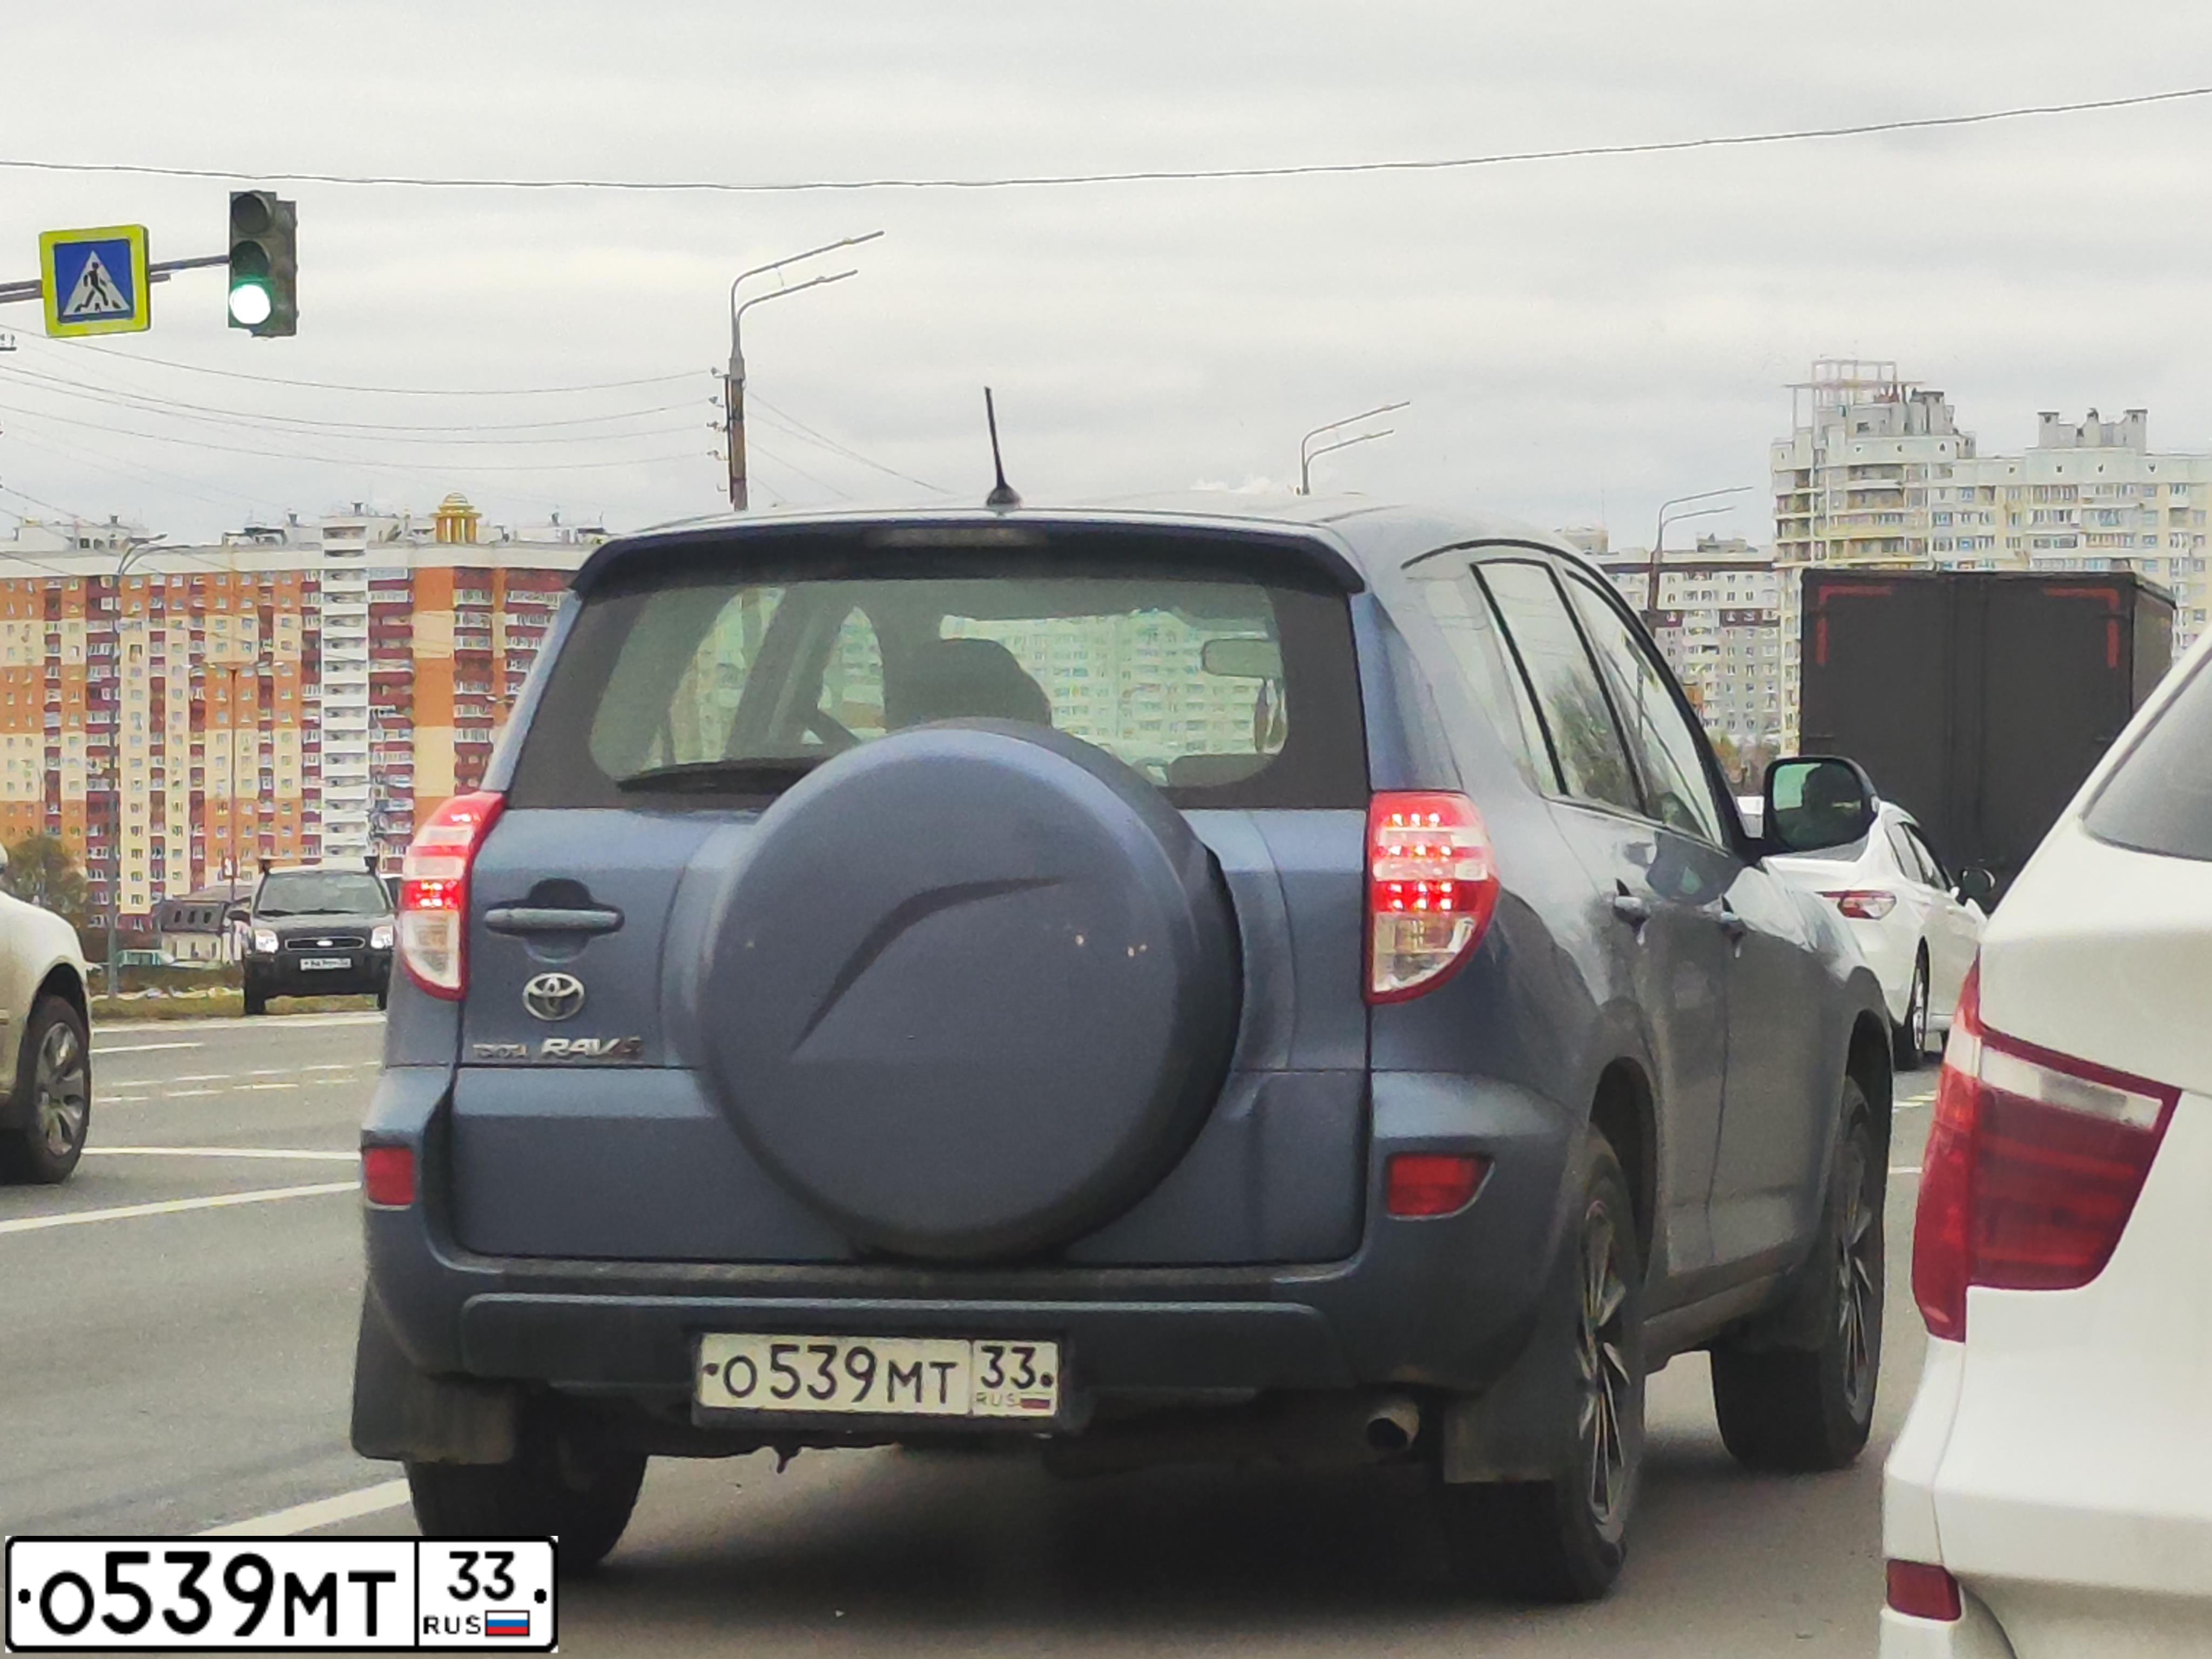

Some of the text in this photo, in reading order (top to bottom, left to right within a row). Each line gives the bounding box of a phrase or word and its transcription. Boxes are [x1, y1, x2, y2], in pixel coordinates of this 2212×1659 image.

[724, 1344, 1036, 1404] О539МТ 33
[976, 1392, 1018, 1406] RUS
